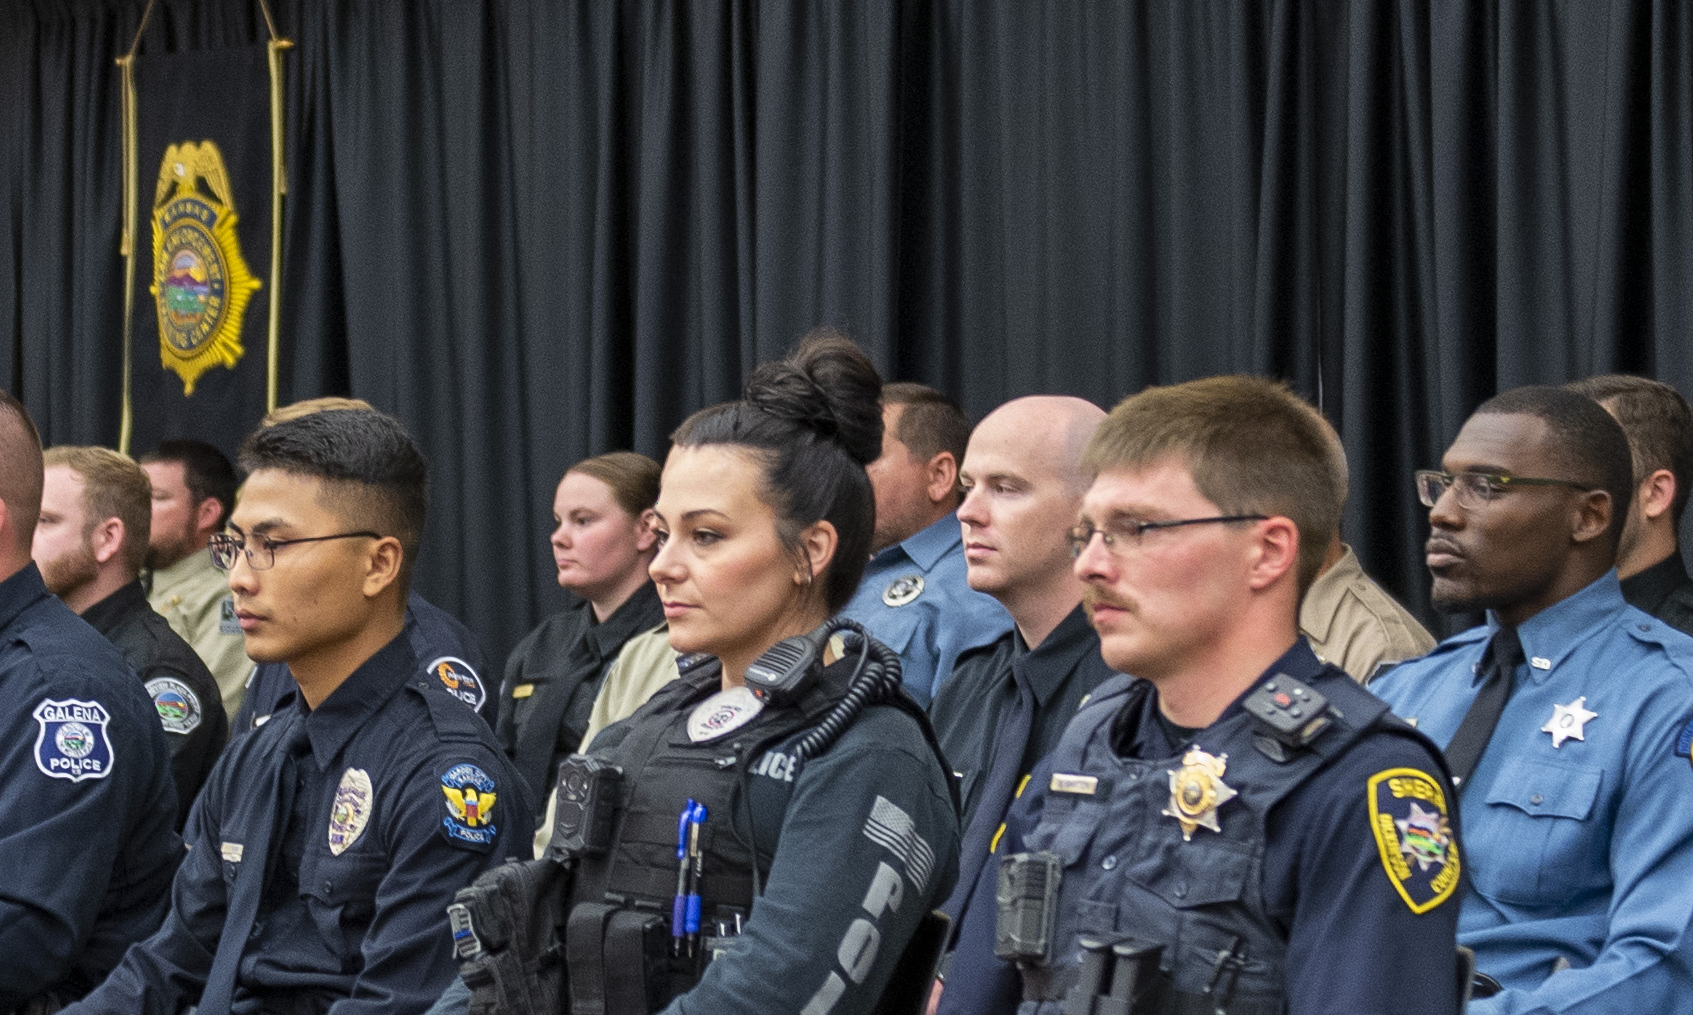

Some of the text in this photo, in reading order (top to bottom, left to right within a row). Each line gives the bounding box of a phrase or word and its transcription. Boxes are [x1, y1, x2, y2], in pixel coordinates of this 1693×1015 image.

[164, 202, 209, 222] KANSAS
[44, 706, 102, 722] GALENA
[49, 757, 102, 772] POLICE
[460, 829, 485, 841] POLICE
